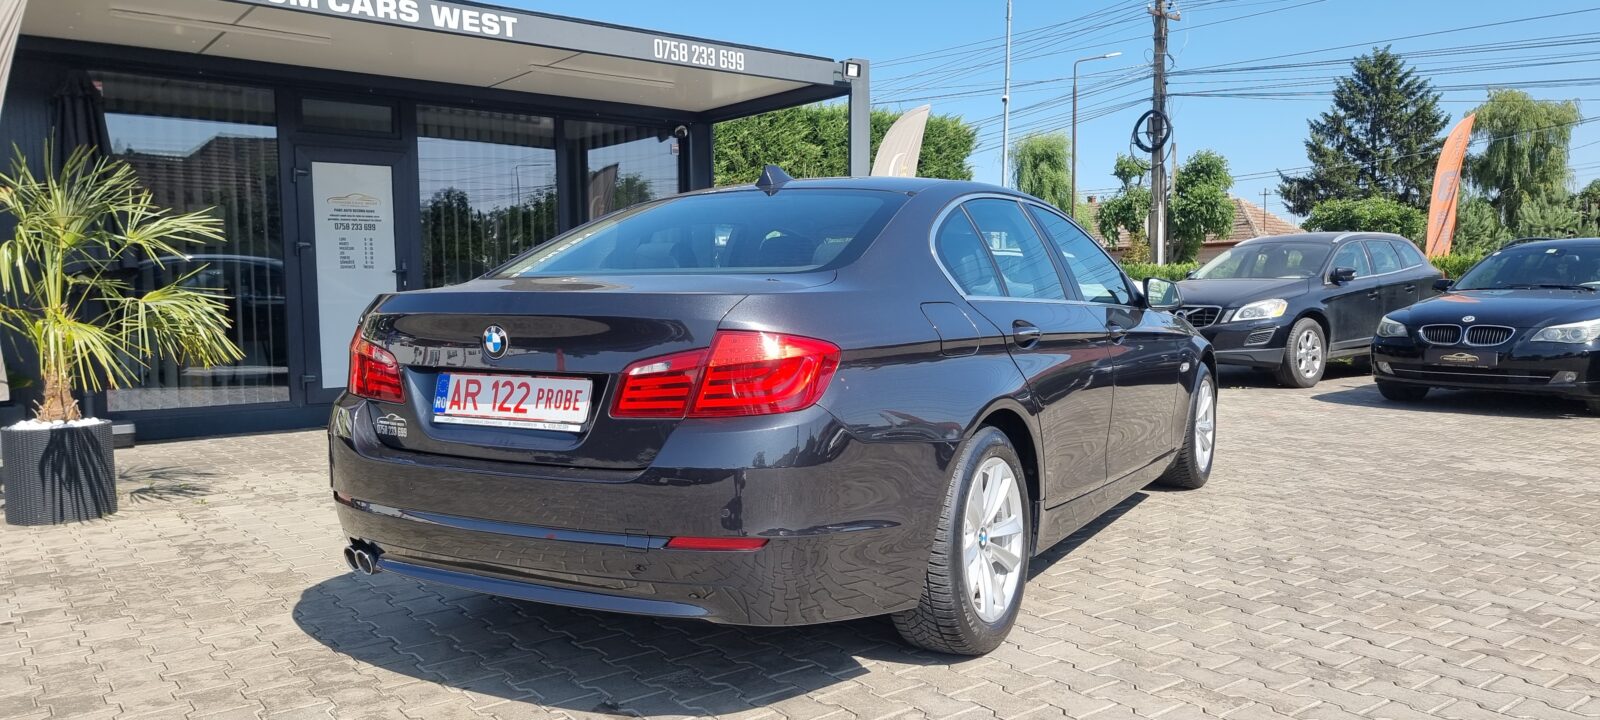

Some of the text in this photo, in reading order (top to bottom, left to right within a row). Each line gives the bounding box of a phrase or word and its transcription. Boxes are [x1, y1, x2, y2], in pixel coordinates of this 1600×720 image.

[430, 4, 518, 37] WEST
[654, 38, 745, 71] 0758 233 699
[449, 379, 583, 414] AR 122 PROBE
